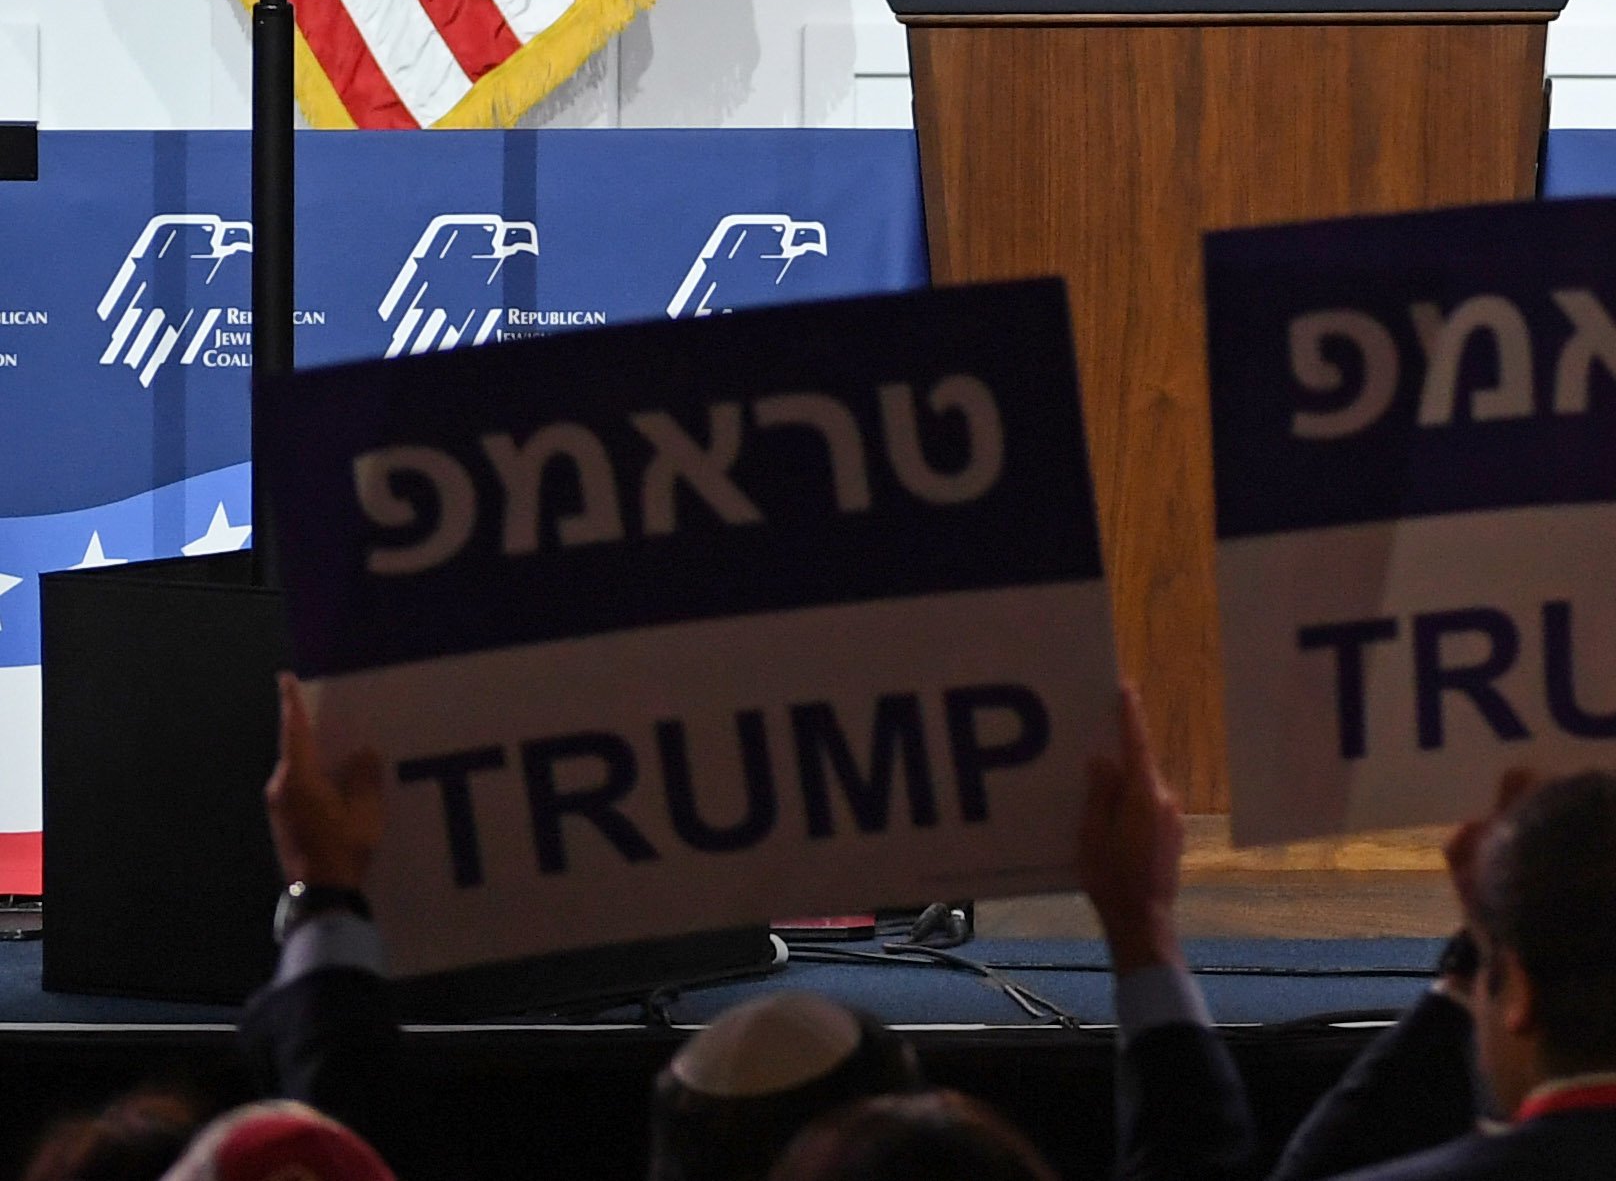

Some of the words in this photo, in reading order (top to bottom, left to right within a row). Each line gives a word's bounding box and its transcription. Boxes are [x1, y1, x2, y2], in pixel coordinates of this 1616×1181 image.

[214, 328, 251, 349] JEWI
[508, 308, 606, 325] REPUBLICAN
[352, 372, 1007, 578] טראמפ
[393, 682, 1051, 890] TRUMP
